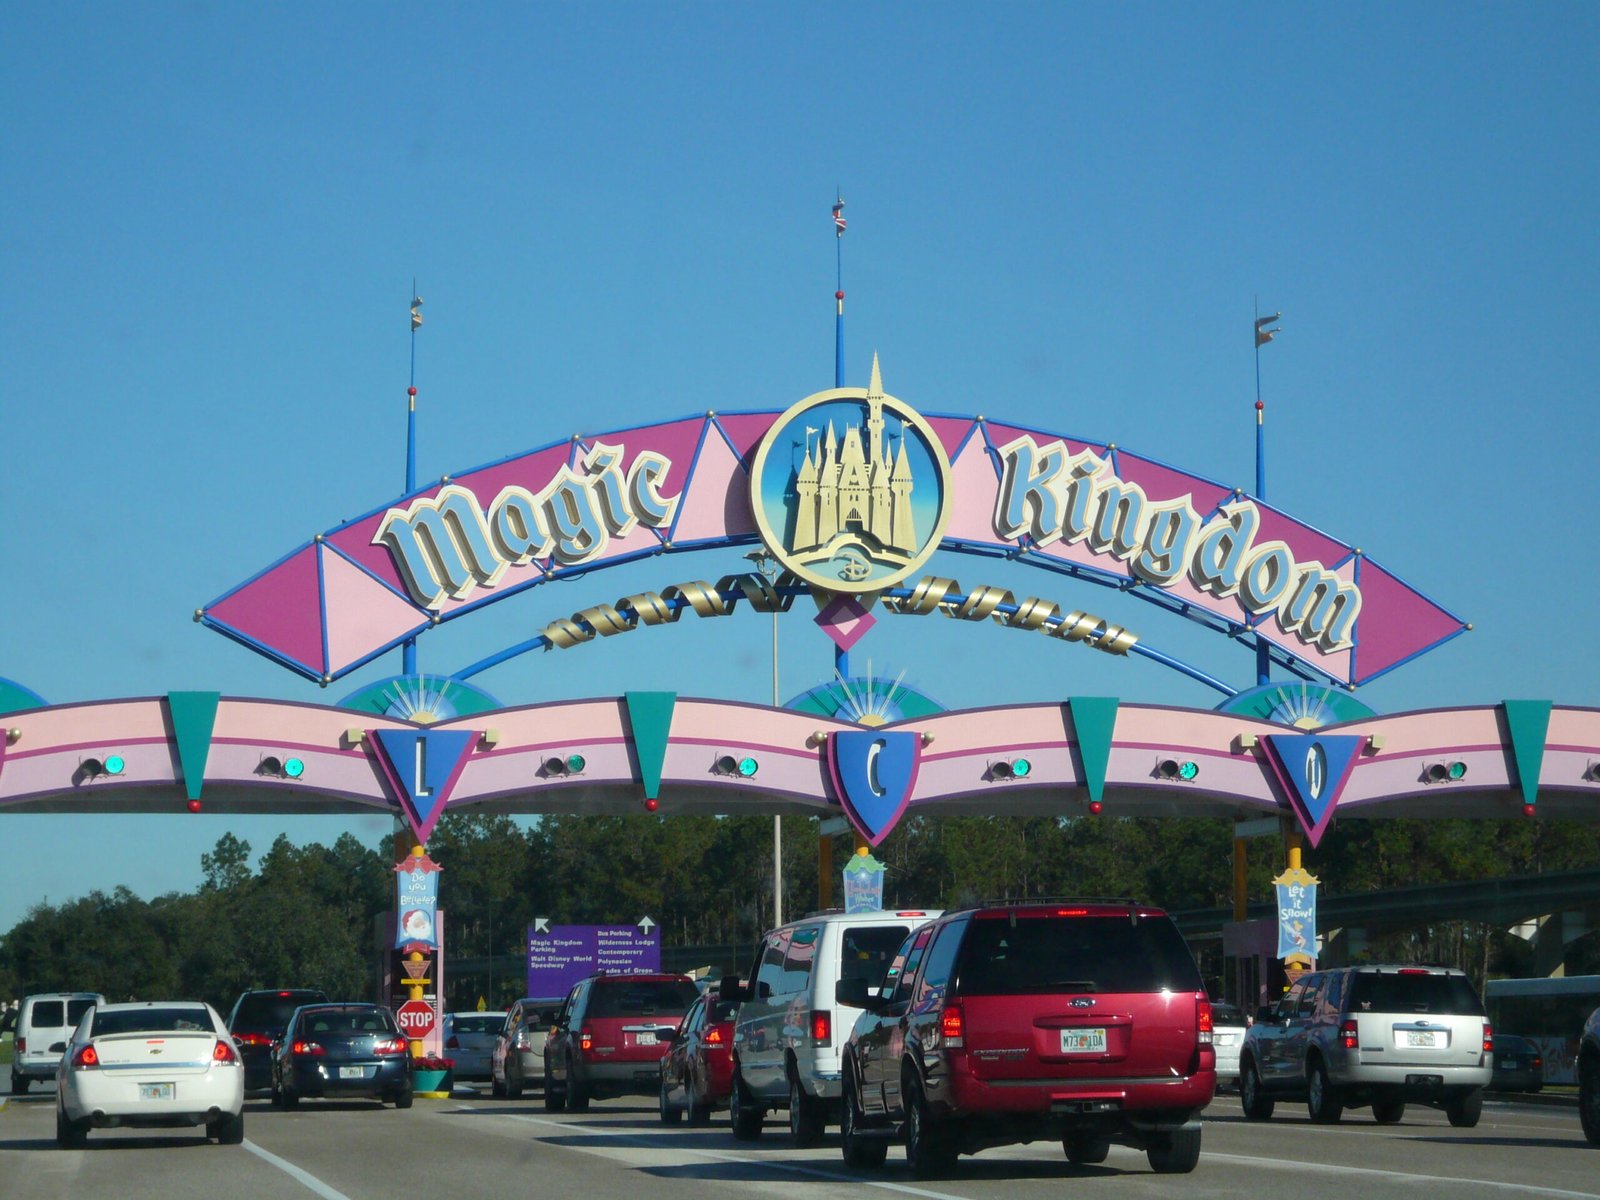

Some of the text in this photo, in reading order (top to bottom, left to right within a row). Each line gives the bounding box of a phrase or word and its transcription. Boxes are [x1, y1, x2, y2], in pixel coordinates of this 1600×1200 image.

[370, 434, 1362, 654] Magic Kingdom
[415, 738, 431, 796] L
[867, 740, 884, 797] C
[411, 872, 425, 882] Do
[409, 883, 426, 893] you
[1288, 885, 1304, 898] Let
[1293, 898, 1301, 909] it
[1281, 907, 1313, 920] Snow!
[400, 1012, 433, 1027] STOP
